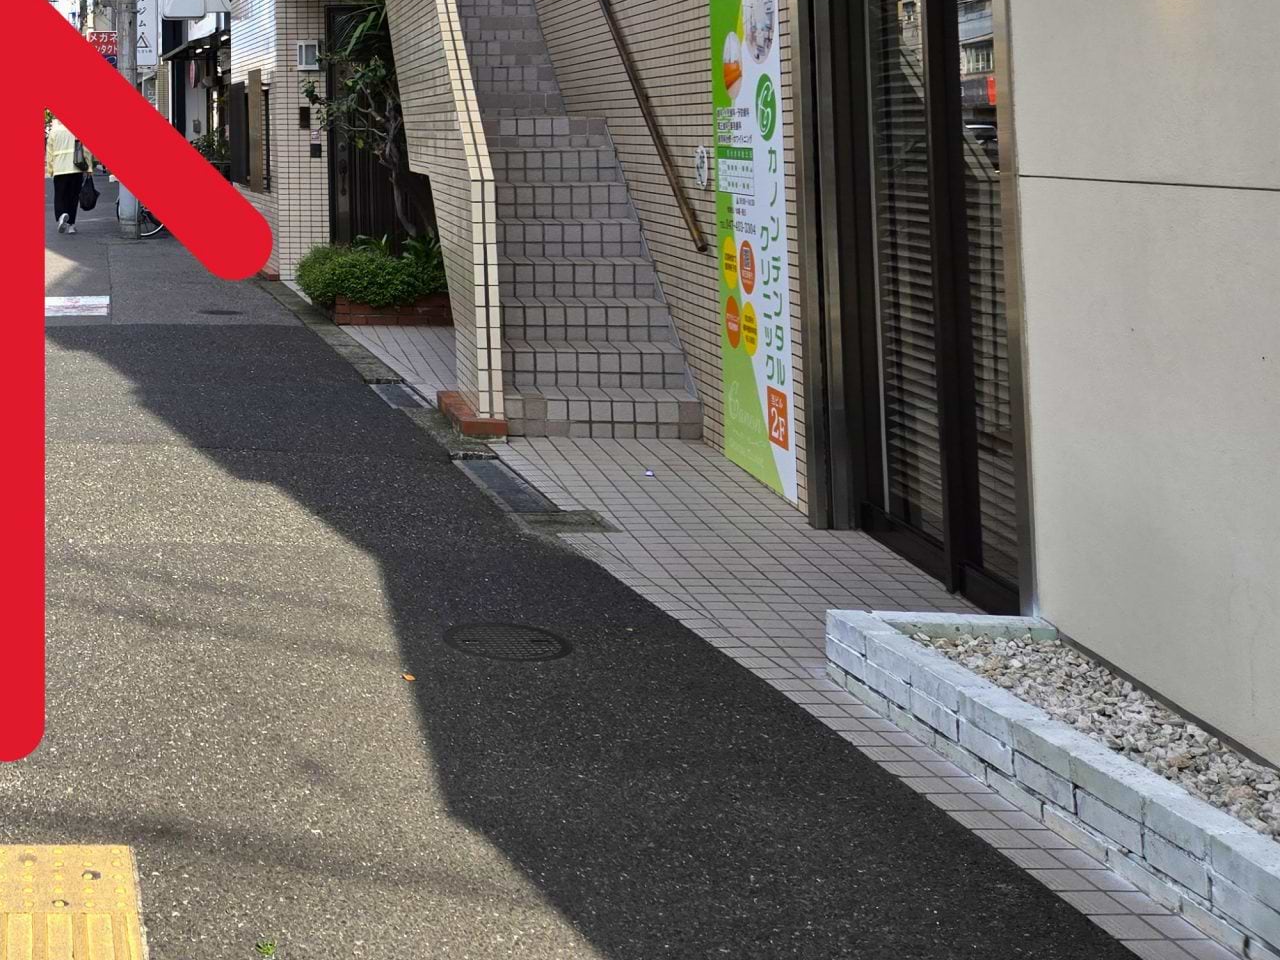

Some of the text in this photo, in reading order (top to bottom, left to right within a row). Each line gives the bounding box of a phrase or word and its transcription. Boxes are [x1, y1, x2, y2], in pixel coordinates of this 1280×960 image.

[90, 33, 118, 42] メガネ
[760, 225, 775, 381] クリニック
[767, 146, 786, 386] カノンデンタル
[771, 407, 786, 441] 2F
